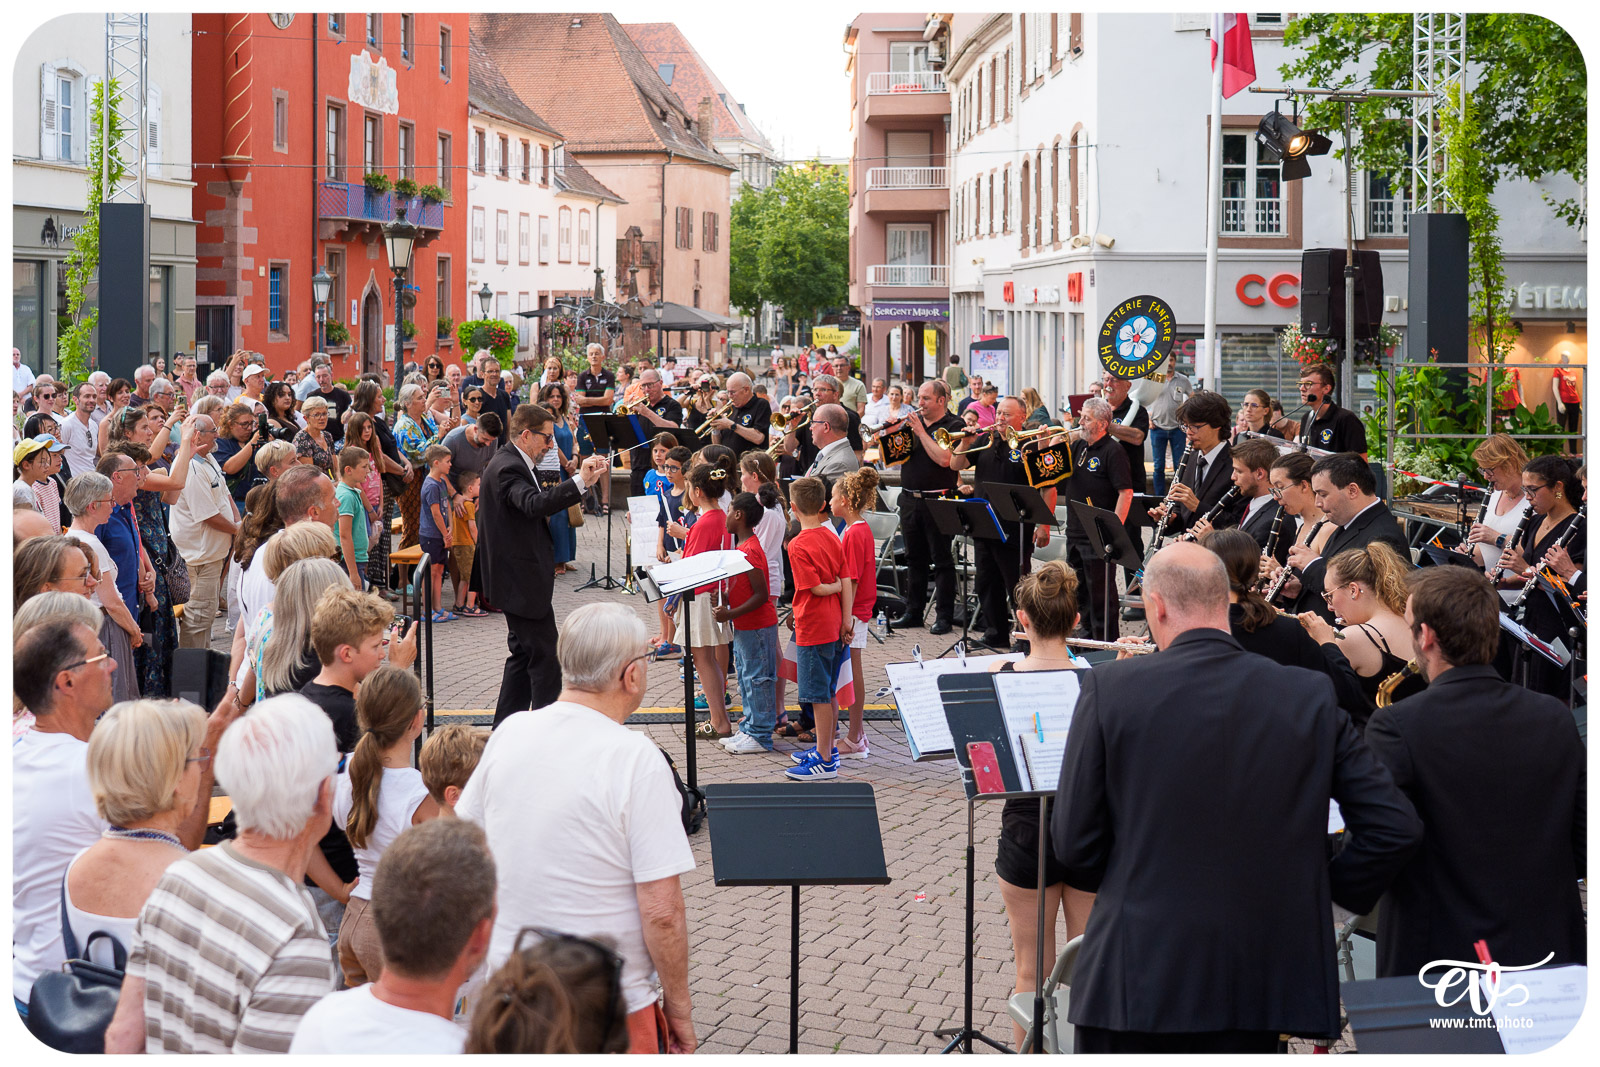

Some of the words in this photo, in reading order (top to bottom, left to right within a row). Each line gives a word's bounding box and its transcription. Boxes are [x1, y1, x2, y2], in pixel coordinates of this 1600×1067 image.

[1235, 273, 1302, 308] CC
[1102, 299, 1142, 336] BATTERIE
[1148, 301, 1171, 342] FANFARE
[1100, 344, 1162, 377] HAGUENAU
